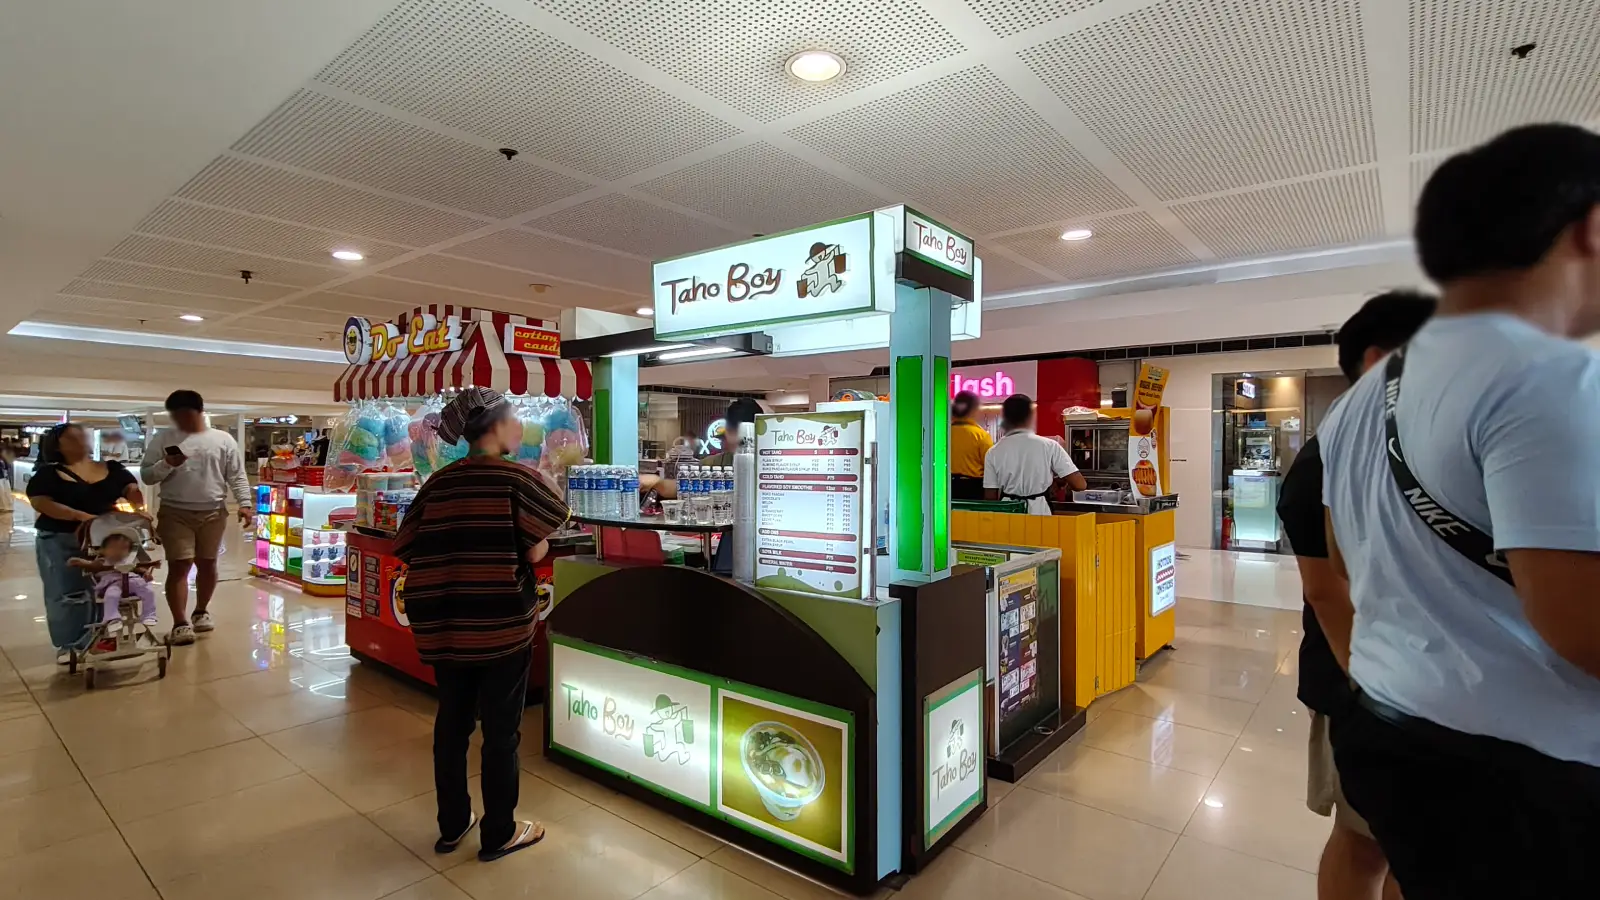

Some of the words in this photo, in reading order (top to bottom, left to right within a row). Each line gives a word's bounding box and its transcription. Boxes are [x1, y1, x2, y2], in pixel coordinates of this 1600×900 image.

[913, 221, 943, 251] Taho
[946, 236, 967, 265] Boy
[661, 275, 720, 315] Taho
[726, 262, 782, 302] Boy
[370, 322, 404, 361] Do
[408, 314, 450, 354] Eat
[515, 330, 558, 342] cotton
[1386, 377, 1400, 420] NIKE
[771, 430, 794, 445] Taho
[796, 430, 815, 444] Boy
[1404, 487, 1470, 538] NIKE
[561, 683, 598, 721] Taho
[603, 696, 634, 740] Boy
[932, 762, 957, 801] Taho
[959, 748, 977, 782] Boy
